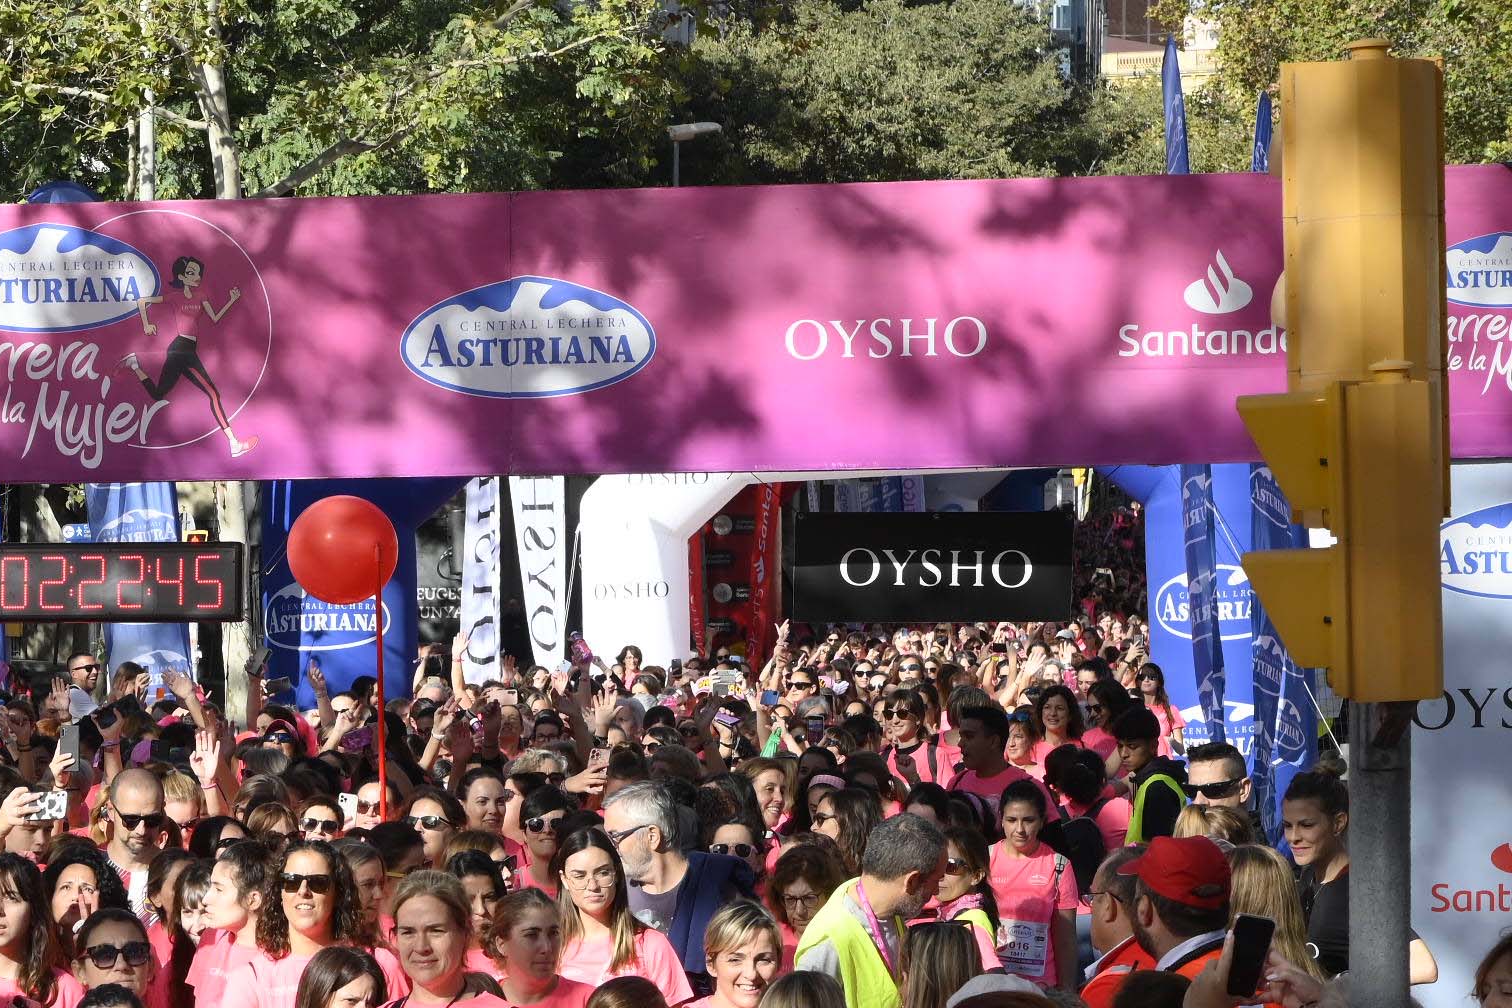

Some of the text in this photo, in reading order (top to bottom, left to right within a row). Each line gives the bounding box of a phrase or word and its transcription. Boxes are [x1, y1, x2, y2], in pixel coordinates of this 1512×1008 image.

[63, 259, 135, 272] LECHERA
[420, 323, 636, 368] ASTURIANA
[459, 316, 627, 332] CENTRAL LECHERA
[785, 316, 988, 361] OYSHO
[1468, 344, 1486, 371] la
[1, 384, 26, 423] la
[21, 376, 170, 469] Mujer
[0, 555, 223, 609] 02:22:45
[839, 547, 1033, 588] OYSHO
